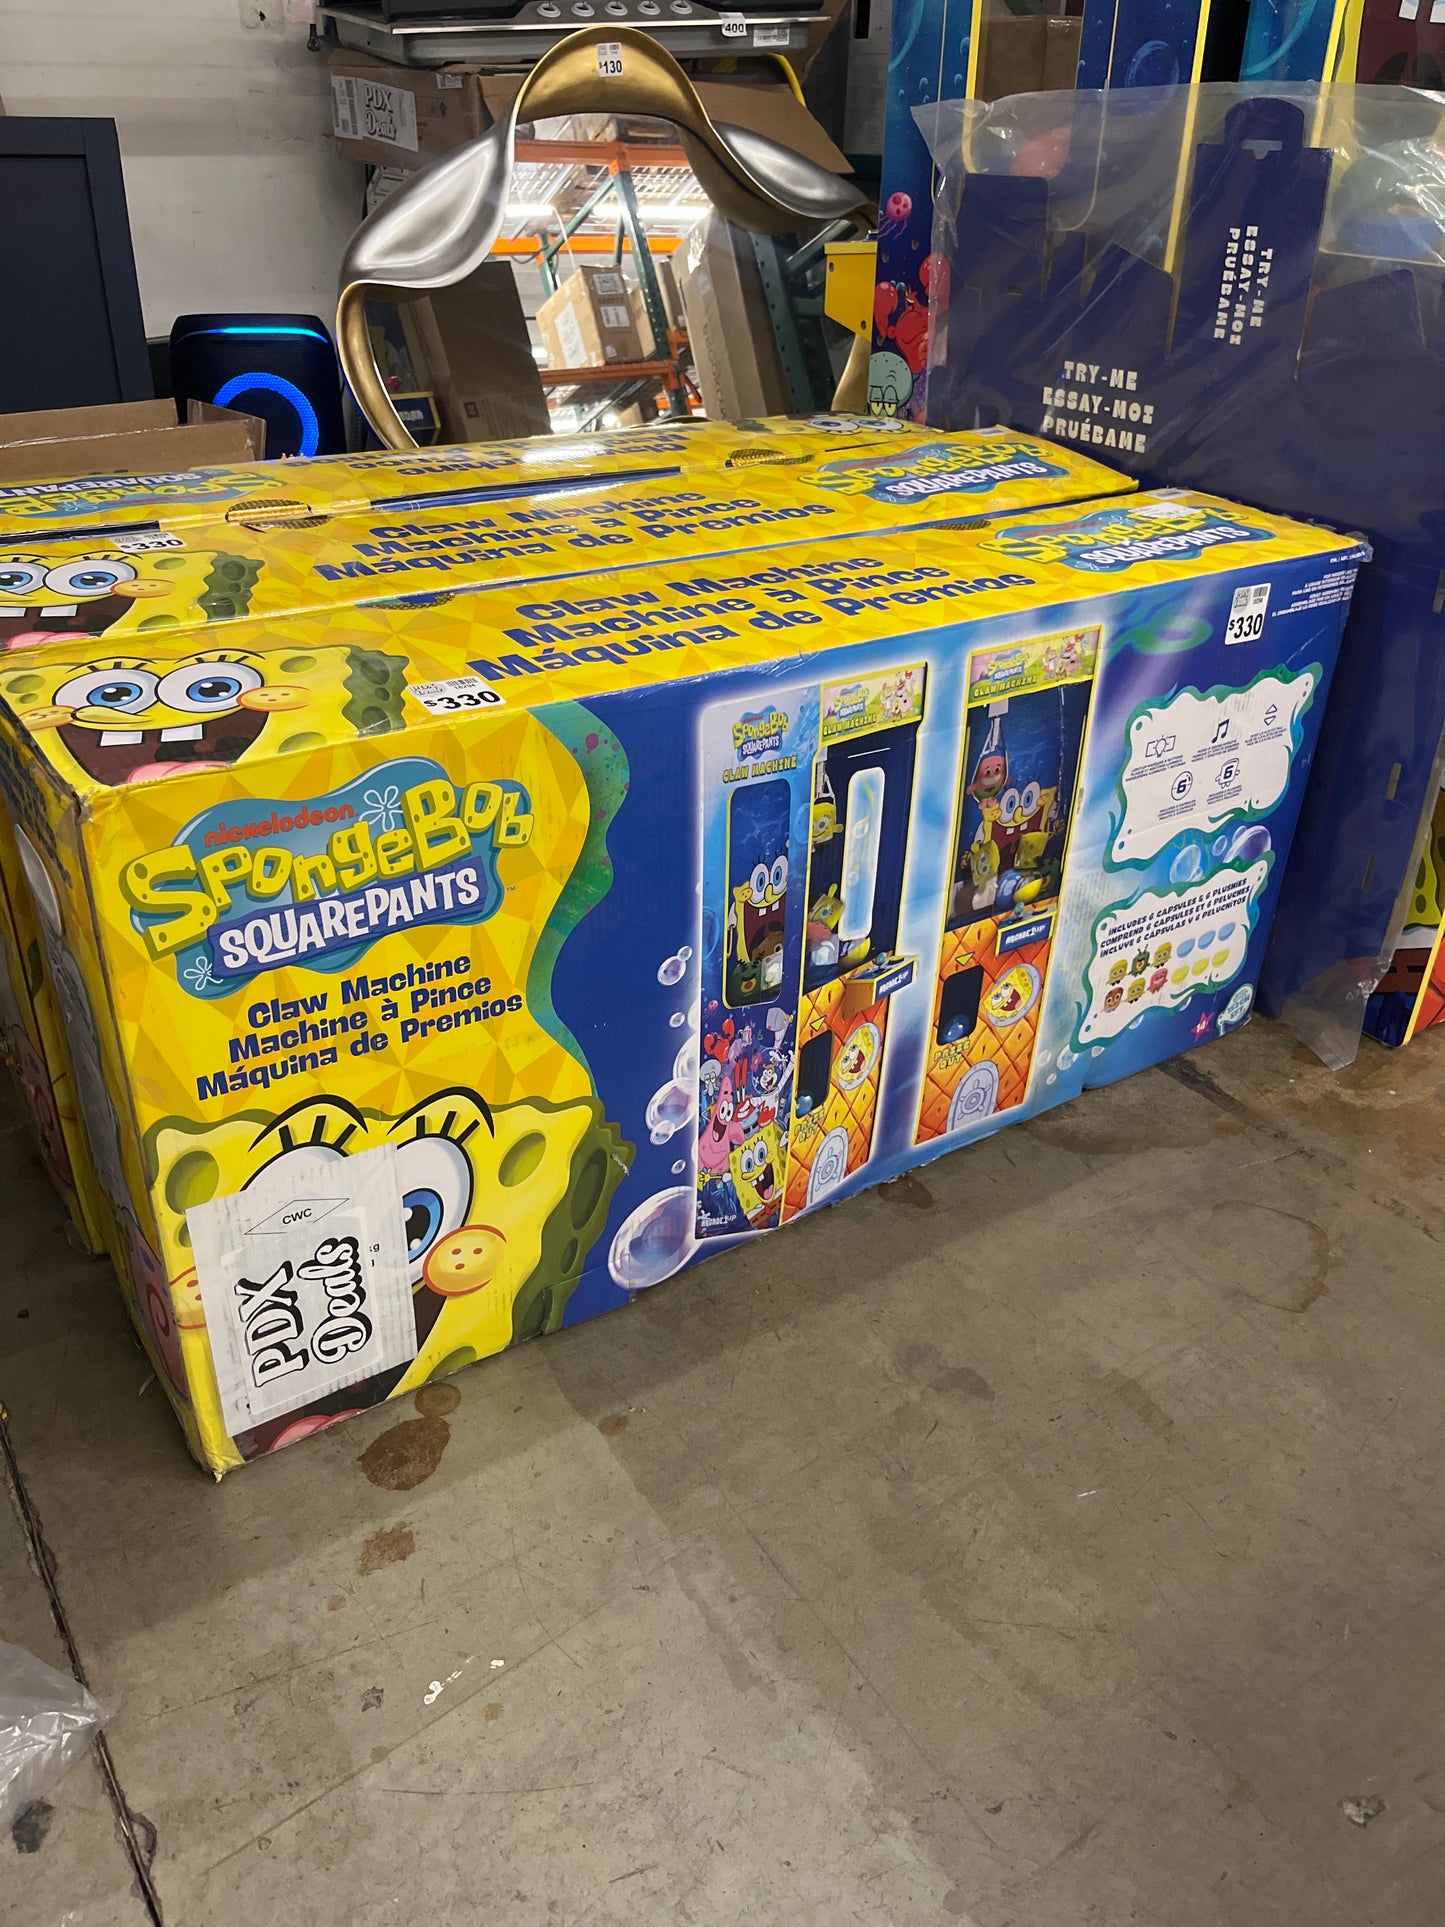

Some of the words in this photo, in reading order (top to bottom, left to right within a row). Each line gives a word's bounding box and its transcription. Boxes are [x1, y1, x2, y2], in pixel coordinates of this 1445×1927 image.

[598, 60, 623, 74] $130
[364, 85, 394, 113] PDX
[1213, 227, 1240, 339] PRUÉBAME
[1229, 225, 1258, 345] ESSAY-MOI
[1250, 248, 1273, 327] TRY-ME
[1064, 360, 1138, 391] TRY-ME
[1042, 386, 1155, 425] ESSAY-MOI
[1042, 415, 1146, 453] PRUÉBAME
[798, 443, 1054, 495] SpongeBob
[885, 461, 1048, 497] SQUAREPANTS
[352, 523, 578, 557] Machine
[590, 516, 627, 529] à
[630, 498, 761, 523] Pince
[369, 518, 497, 538] Claw
[507, 492, 706, 524] Machine
[313, 542, 557, 581] Máquina
[567, 532, 634, 548] de
[637, 504, 835, 539] Premios
[1080, 526, 1250, 565] SQUAREPANTS
[503, 598, 756, 647] Machine
[761, 587, 809, 603] à
[805, 566, 950, 595] Pince
[515, 591, 660, 620] Claw
[665, 557, 884, 597] Machine
[466, 624, 740, 681] Máquina
[748, 610, 823, 630] de
[820, 573, 1036, 617] Premios
[1229, 613, 1263, 639] $330
[424, 691, 500, 709] $330
[974, 685, 996, 698] CLAW
[1000, 675, 1037, 691] MACHINE
[732, 711, 789, 749] SpongeBob
[742, 735, 779, 755] SQUAREPANTS
[823, 722, 843, 736] CLAW
[844, 713, 878, 731] MACHINE
[723, 765, 749, 783] CLAW
[752, 756, 797, 777] MACHINE
[1223, 765, 1234, 779] 6
[204, 802, 354, 848] nickelodeon
[118, 779, 535, 961] SpongeBob
[219, 867, 480, 969] SQUAREPANTS
[1100, 926, 1144, 948] COMPREND
[1154, 908, 1194, 928] CAPSULES
[1195, 903, 1206, 914] ET
[1108, 915, 1148, 936] INCLUDES
[1157, 897, 1197, 918] CAPSULES
[1144, 920, 1186, 941] CAPSULAS
[248, 992, 328, 1029] Claw
[341, 955, 471, 1004] Machine
[228, 1011, 367, 1063] Machine
[381, 998, 398, 1022] à
[410, 976, 492, 1014] Pince
[196, 1045, 338, 1101] Máquina
[350, 1031, 388, 1058] de
[400, 994, 523, 1043] Premios
[282, 1208, 312, 1225] CWC
[297, 1236, 373, 1365] Deals
[234, 1260, 310, 1388] PDX
